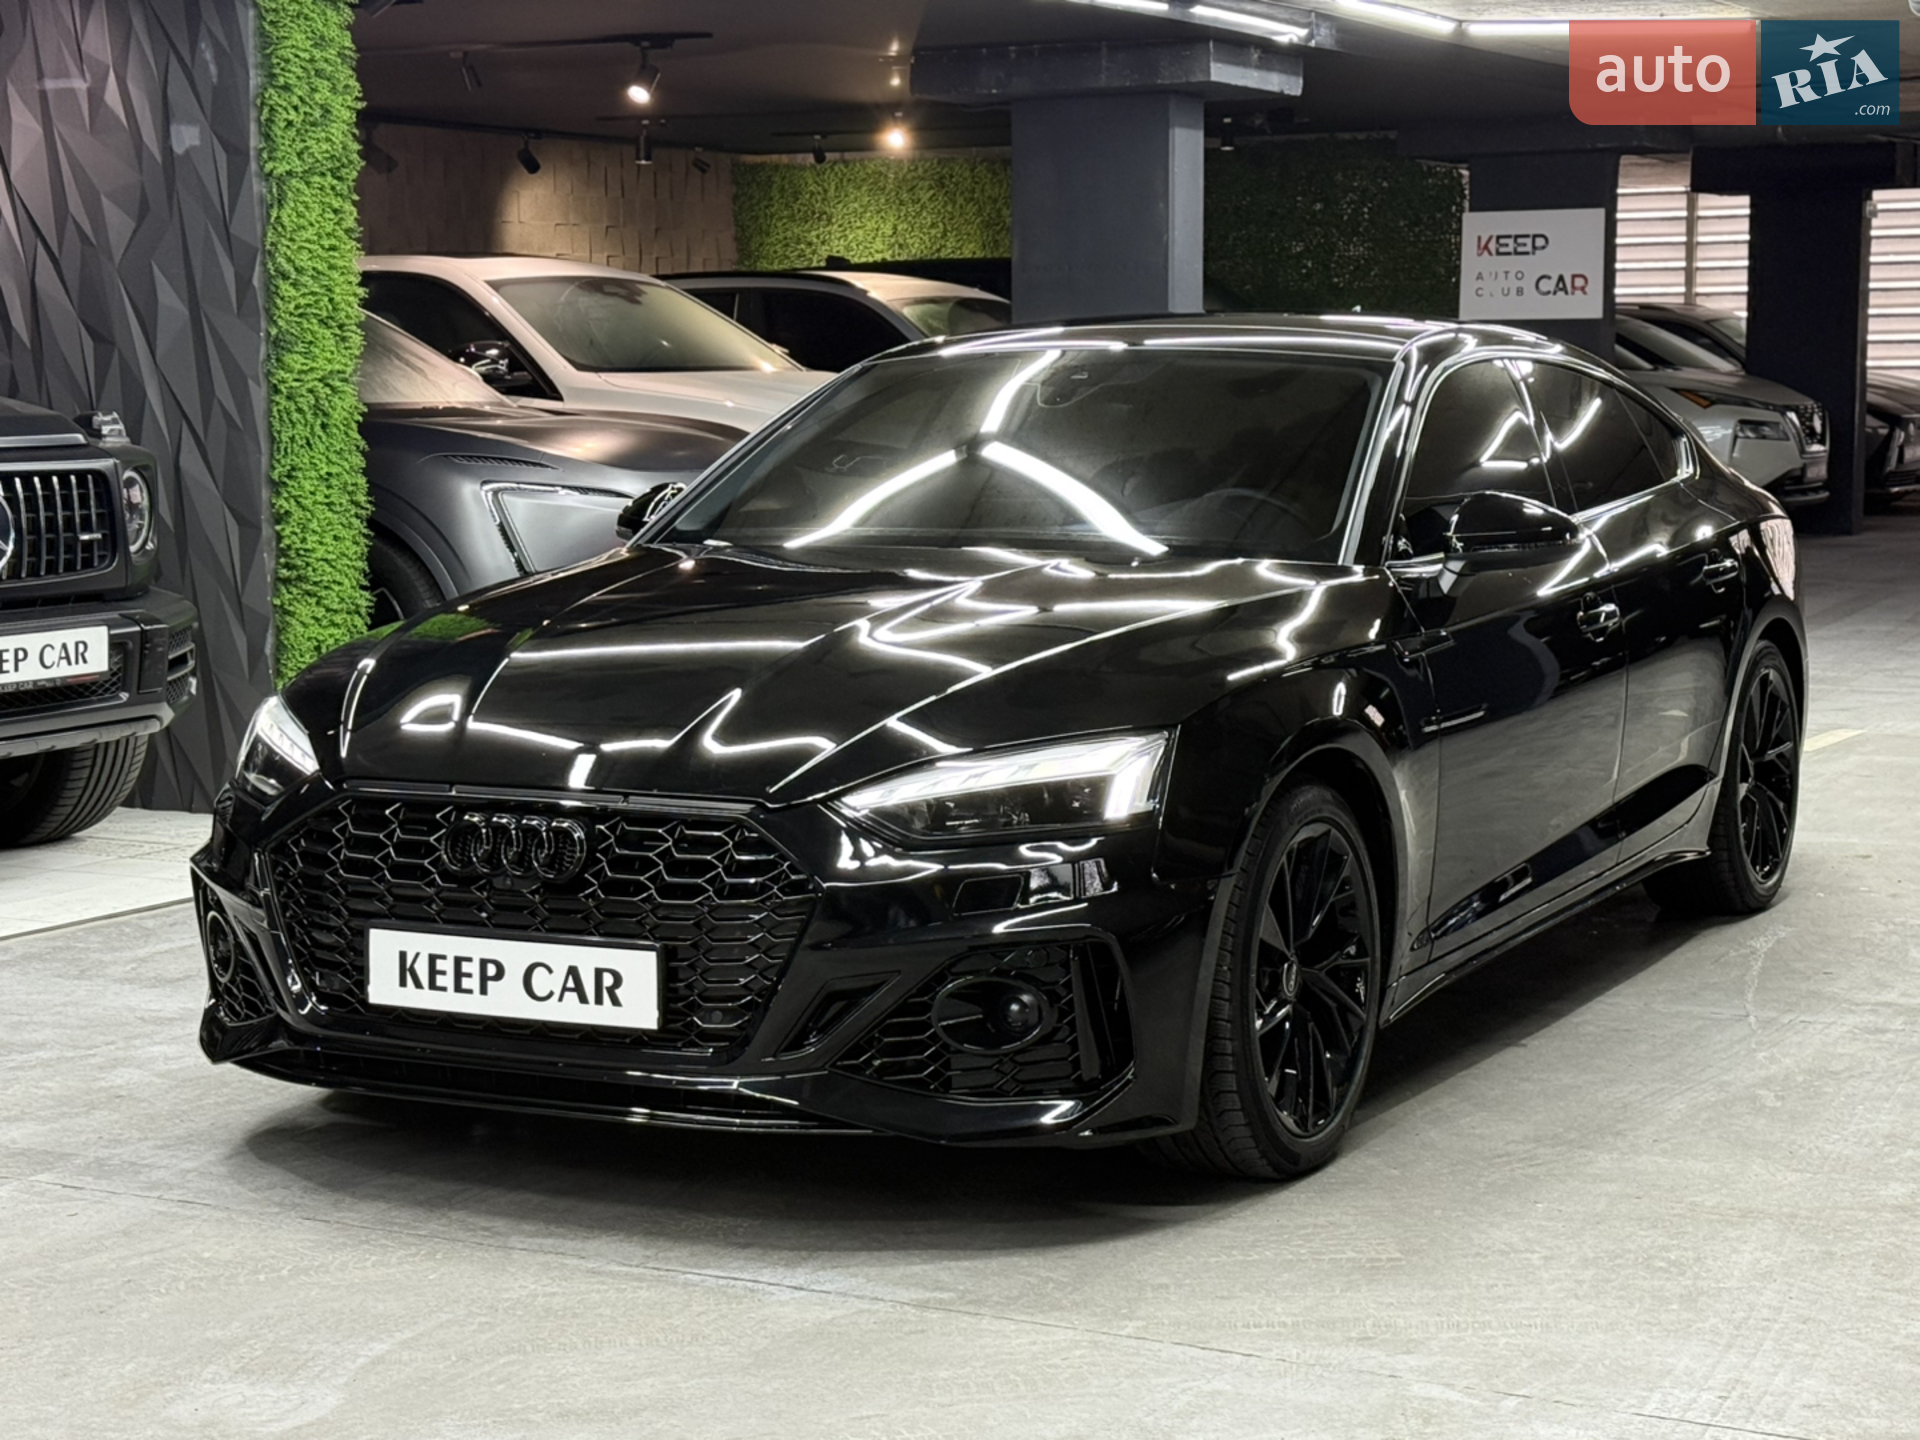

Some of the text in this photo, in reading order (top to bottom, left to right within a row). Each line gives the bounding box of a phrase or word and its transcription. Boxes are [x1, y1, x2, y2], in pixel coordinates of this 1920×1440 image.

[1476, 233, 1550, 257] KEEP
[1475, 270, 1525, 282] AUTO
[1535, 273, 1589, 296] CAR
[38, 640, 89, 670] CAR
[398, 949, 624, 1008] KEEP CAR
